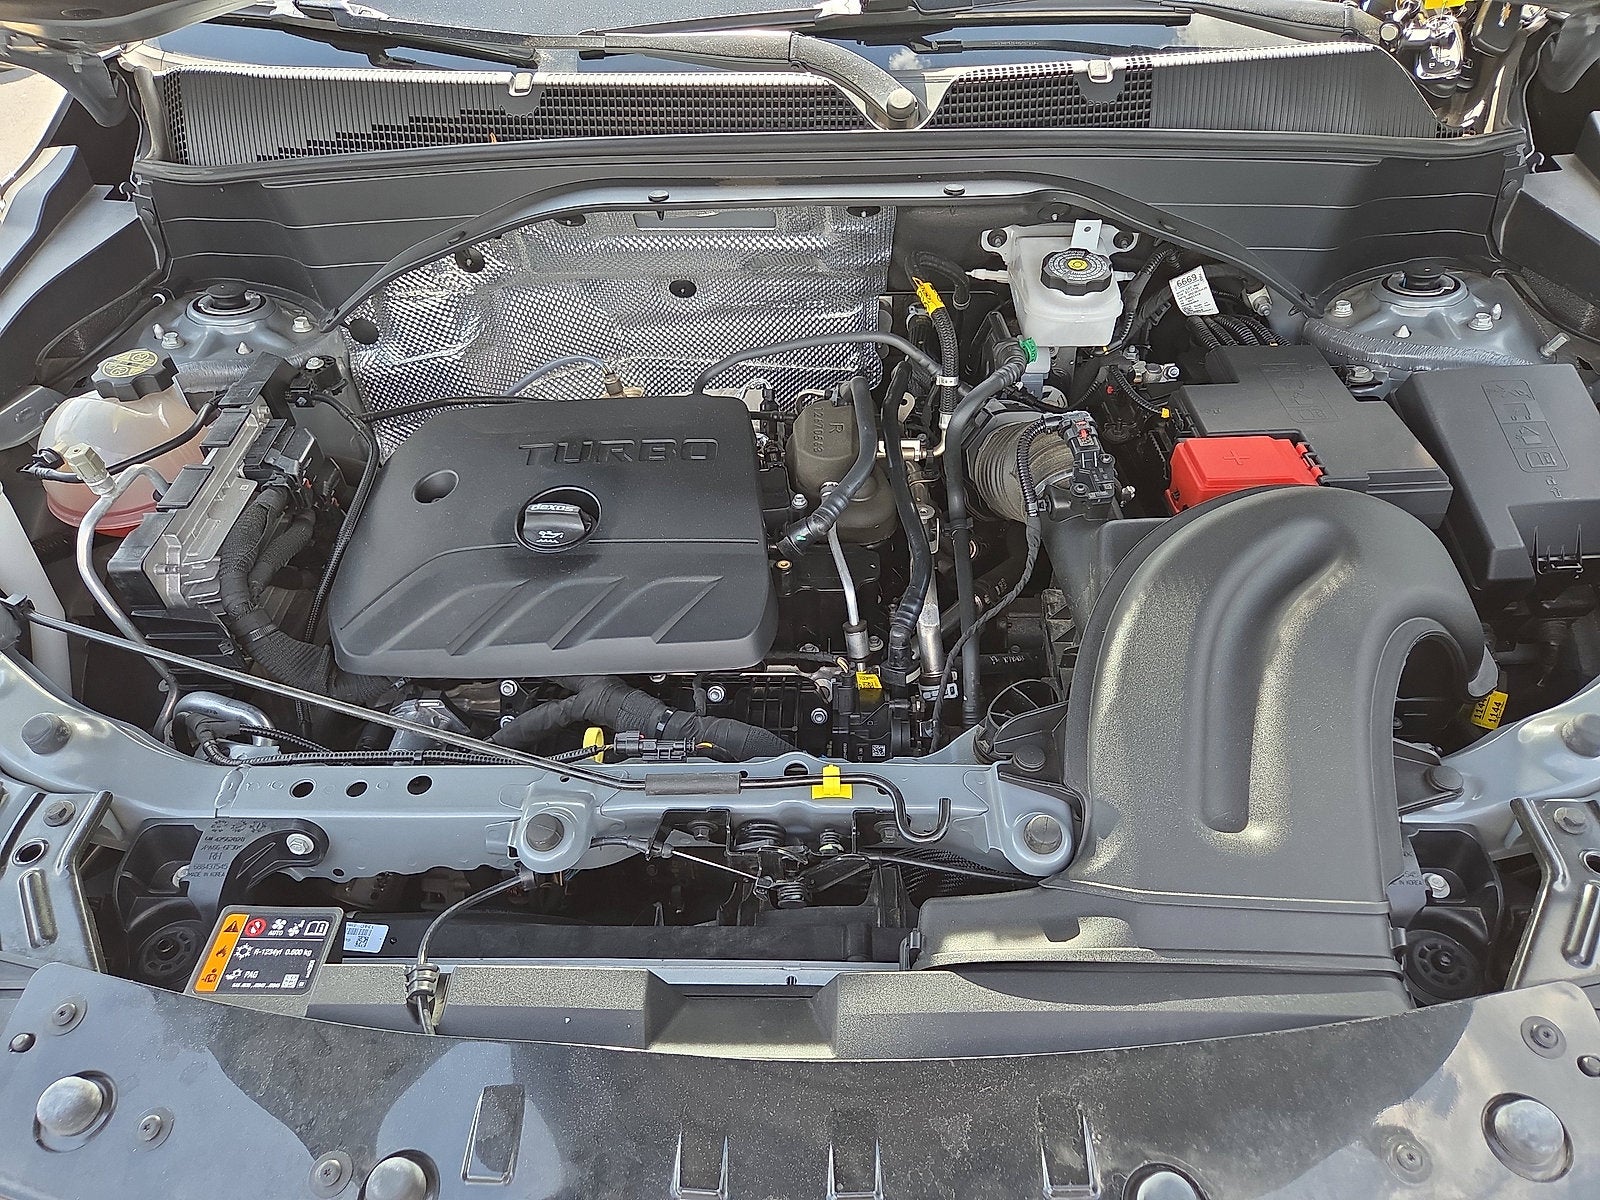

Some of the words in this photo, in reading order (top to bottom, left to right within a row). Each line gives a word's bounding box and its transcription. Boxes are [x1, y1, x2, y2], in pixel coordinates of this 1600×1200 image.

[1176, 274, 1197, 287] 6669
[829, 423, 844, 433] R
[518, 438, 719, 465] TURBO
[530, 503, 574, 511] dexos
[1488, 701, 1501, 723] 1144
[303, 949, 313, 957] kg
[243, 971, 259, 979] PAG
